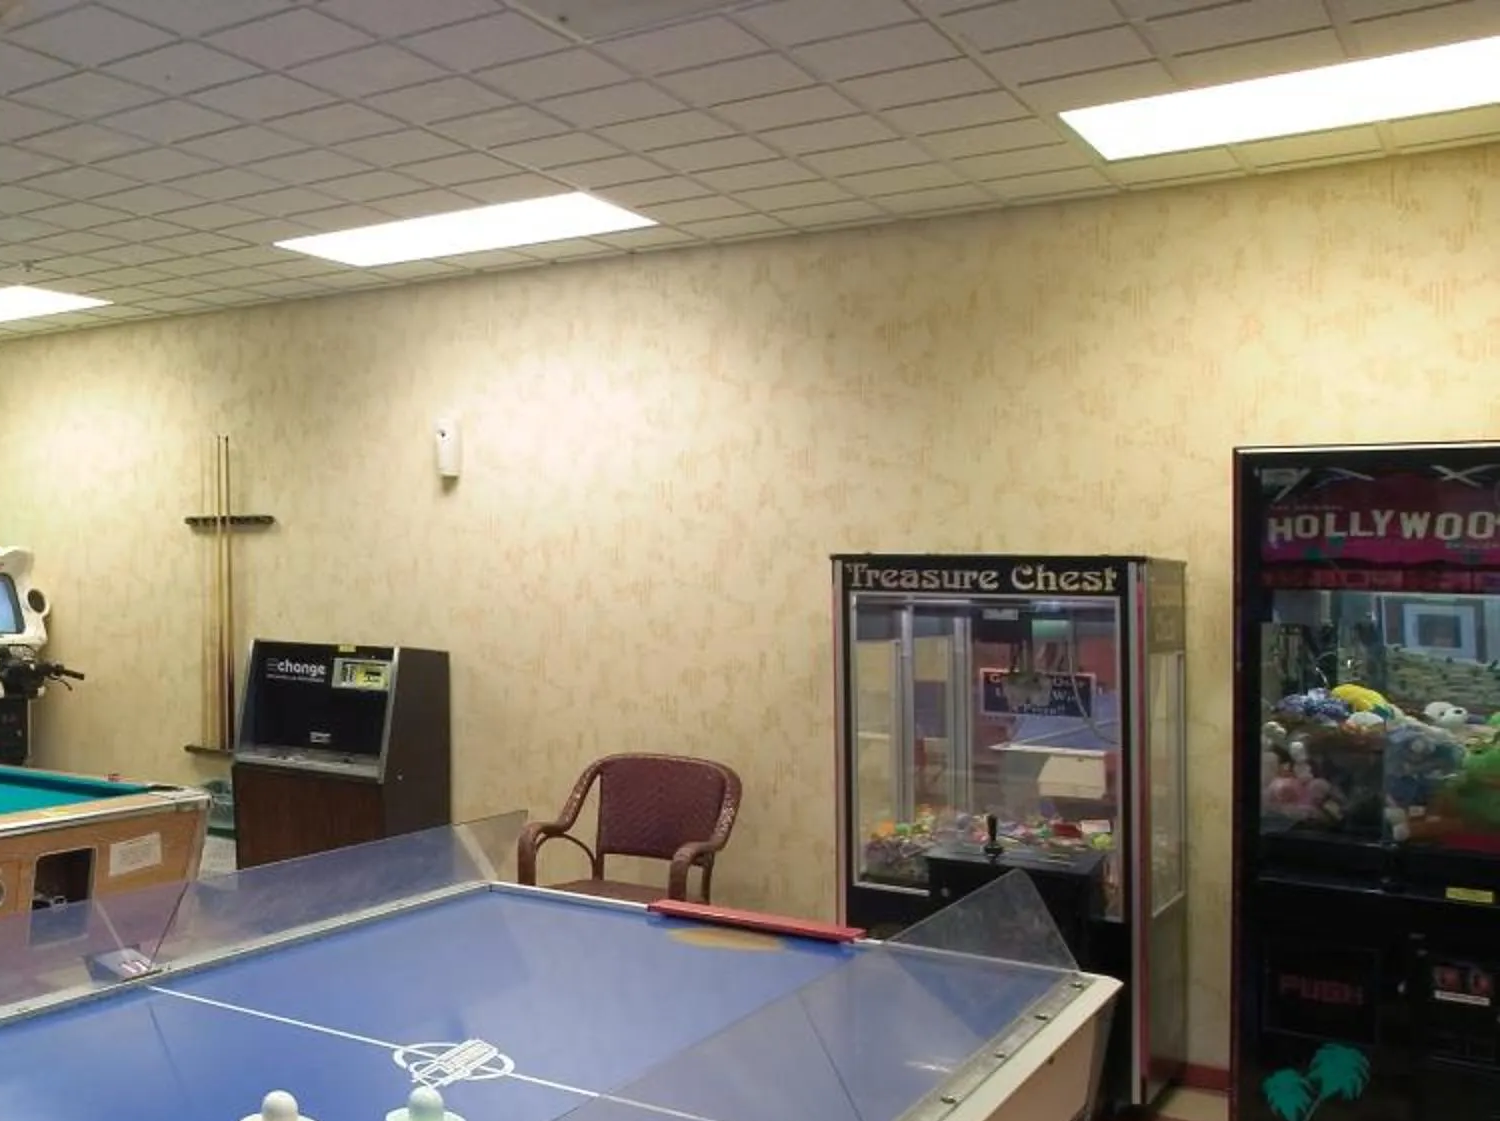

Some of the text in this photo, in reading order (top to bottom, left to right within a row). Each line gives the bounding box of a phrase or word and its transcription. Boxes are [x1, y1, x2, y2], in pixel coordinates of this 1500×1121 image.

[1267, 509, 1500, 546] HOLLYWOO
[846, 563, 1117, 591] Treasure Chest
[277, 659, 326, 677] change
